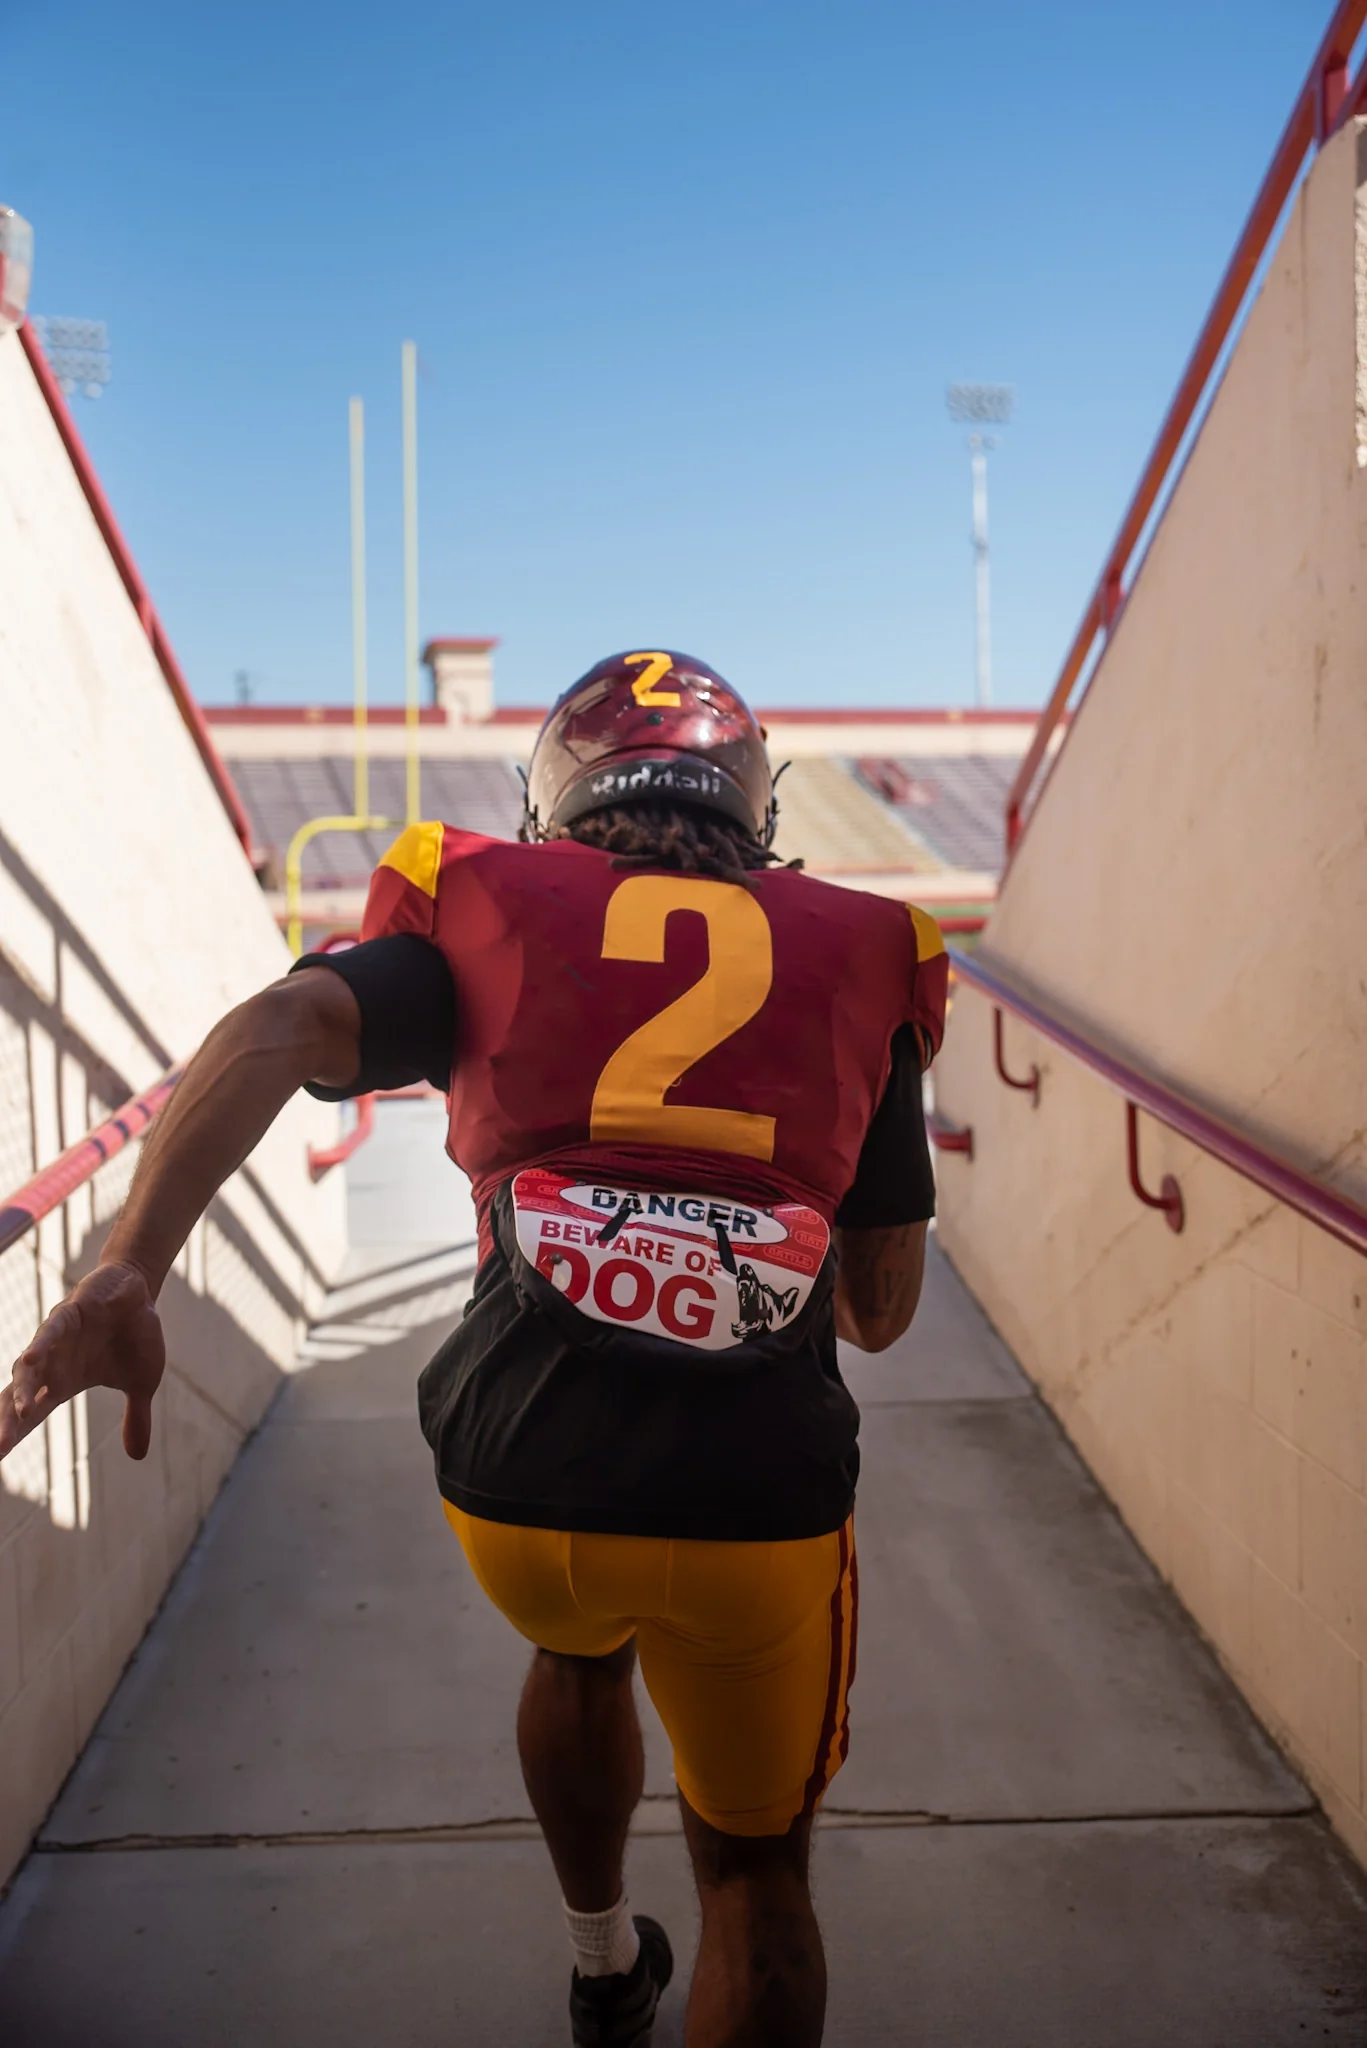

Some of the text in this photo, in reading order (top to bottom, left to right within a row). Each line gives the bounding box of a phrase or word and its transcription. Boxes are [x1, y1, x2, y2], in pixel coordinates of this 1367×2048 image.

[624, 652, 681, 707] 2
[590, 875, 776, 1163] 2
[592, 1188, 758, 1238] DANGER
[540, 1219, 722, 1277] BEWARE OF
[535, 1241, 717, 1339] DOG
